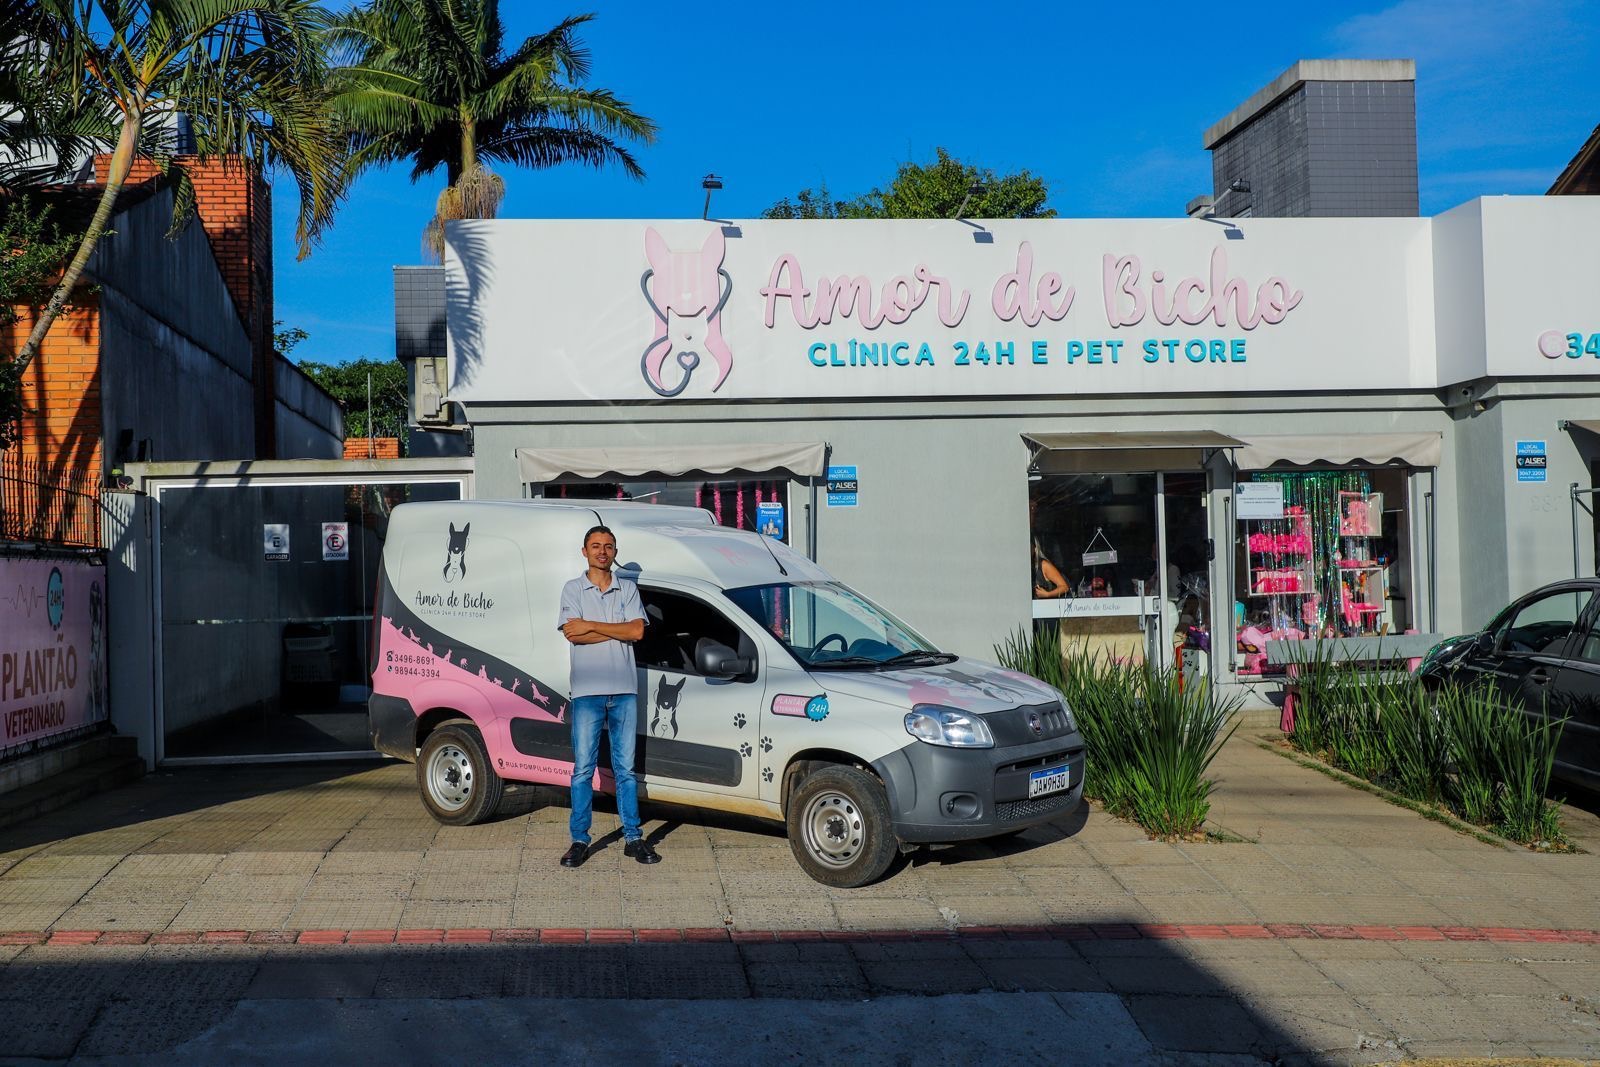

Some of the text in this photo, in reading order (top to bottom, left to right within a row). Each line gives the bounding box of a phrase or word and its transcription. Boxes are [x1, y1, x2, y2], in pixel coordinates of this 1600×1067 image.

[760, 240, 1304, 331] Amor de Bicho
[807, 338, 1247, 368] CLÍNICA 24H E PET STORE
[416, 590, 494, 610] Amor de Bicho
[2, 633, 78, 702] PLANTÃO
[394, 654, 435, 664] 3496-8691
[394, 666, 440, 677] 98944-3394
[5, 697, 65, 738] VETERINÁRIO
[811, 704, 826, 713] 24H
